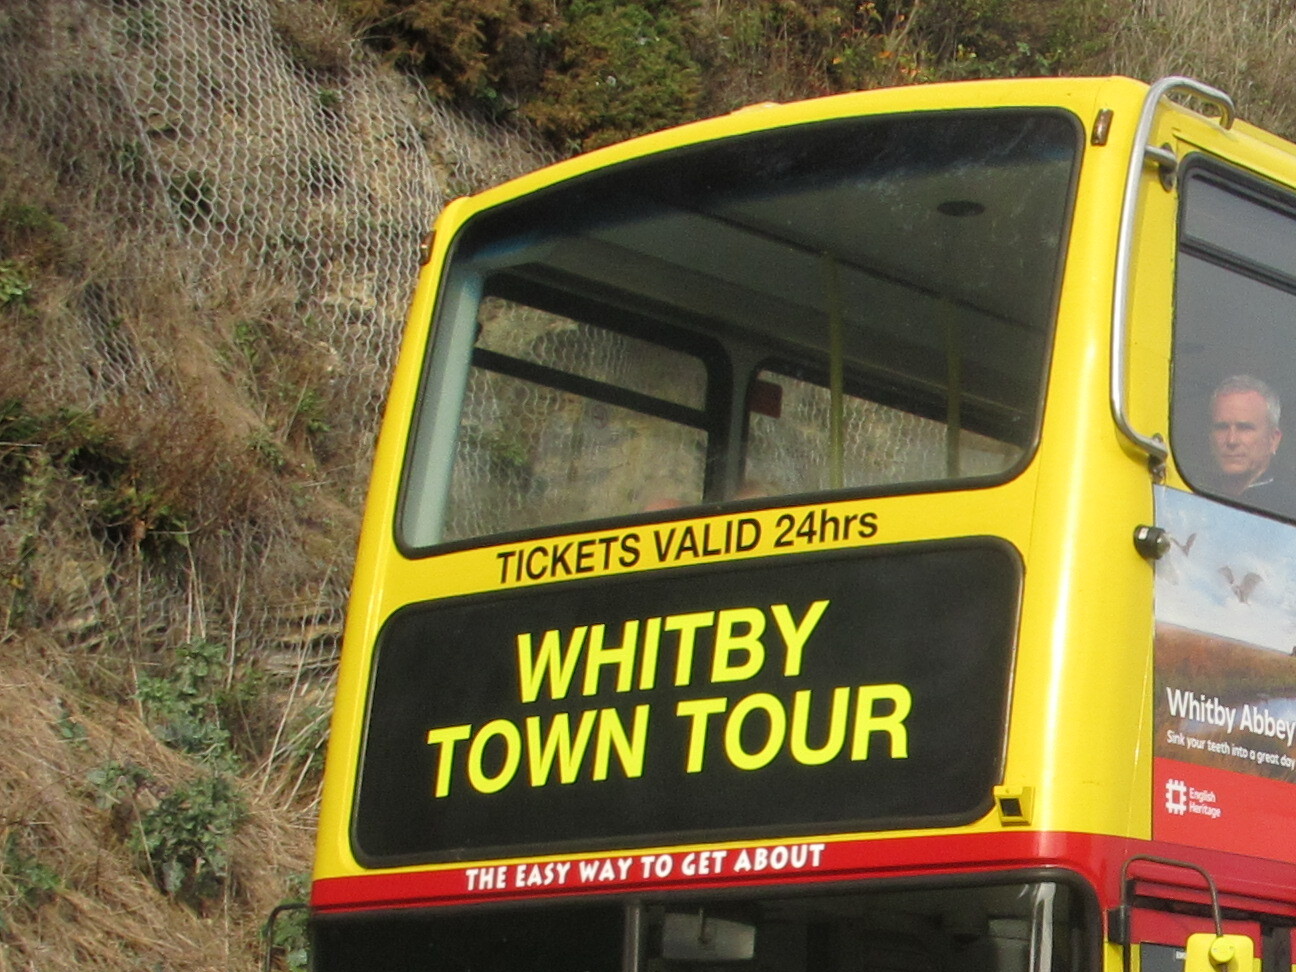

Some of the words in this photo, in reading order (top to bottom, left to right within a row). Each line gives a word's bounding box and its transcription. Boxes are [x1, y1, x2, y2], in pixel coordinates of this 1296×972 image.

[496, 533, 641, 583] TICKETS
[653, 517, 762, 563] VALID
[773, 508, 879, 549] 24hrs
[516, 600, 830, 703] WHITBY
[427, 704, 650, 798] TOWN
[676, 683, 912, 774] TOUR
[1165, 686, 1237, 735] Whitby
[1239, 703, 1296, 748] Abbey
[1166, 729, 1186, 747] Sink
[1186, 736, 1205, 750] your
[1207, 739, 1231, 755] teeth
[1231, 743, 1248, 757] into
[1249, 749, 1256, 761] a
[1257, 751, 1280, 765] great
[1280, 754, 1296, 772] day
[1189, 786, 1217, 803] English
[1189, 800, 1222, 819] Heritage
[465, 866, 507, 892] THE
[515, 861, 572, 887] EASY
[578, 857, 634, 884] WAY
[640, 853, 674, 878] TO
[681, 850, 728, 877] GET
[733, 843, 826, 874] ABOUT
